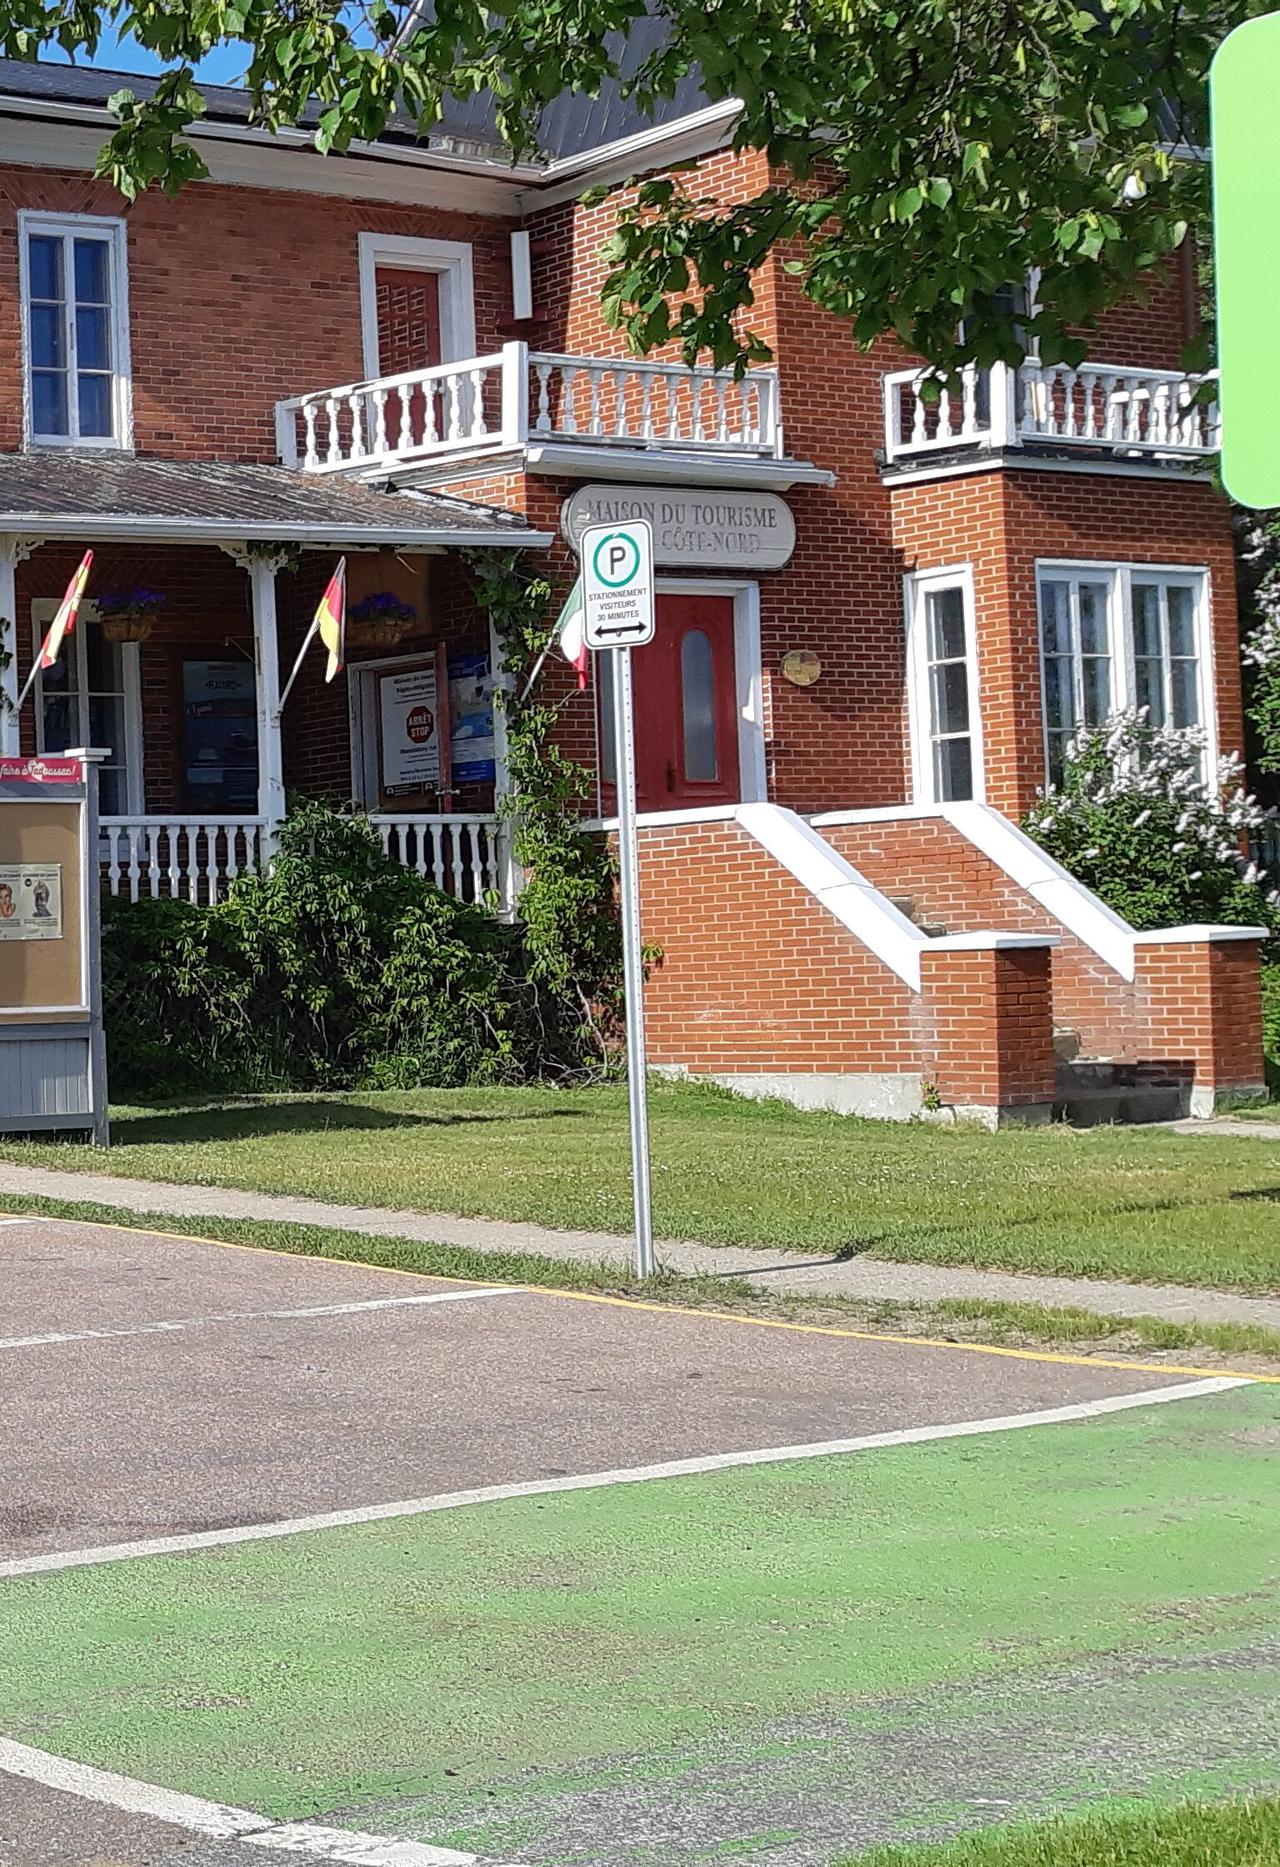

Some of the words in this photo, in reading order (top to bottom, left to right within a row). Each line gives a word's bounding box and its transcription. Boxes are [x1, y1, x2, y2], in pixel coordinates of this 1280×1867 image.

[589, 501, 654, 522] MAISON
[661, 504, 686, 524] DU
[691, 505, 777, 528] TOURISME
[610, 546, 626, 575] P
[588, 588, 647, 601] STATIONNEMENT
[600, 600, 636, 610] VISITEURS
[608, 610, 639, 620] MINUTES
[408, 712, 432, 725] ARRÊT
[411, 727, 430, 738] STOP
[0, 764, 20, 779] faire
